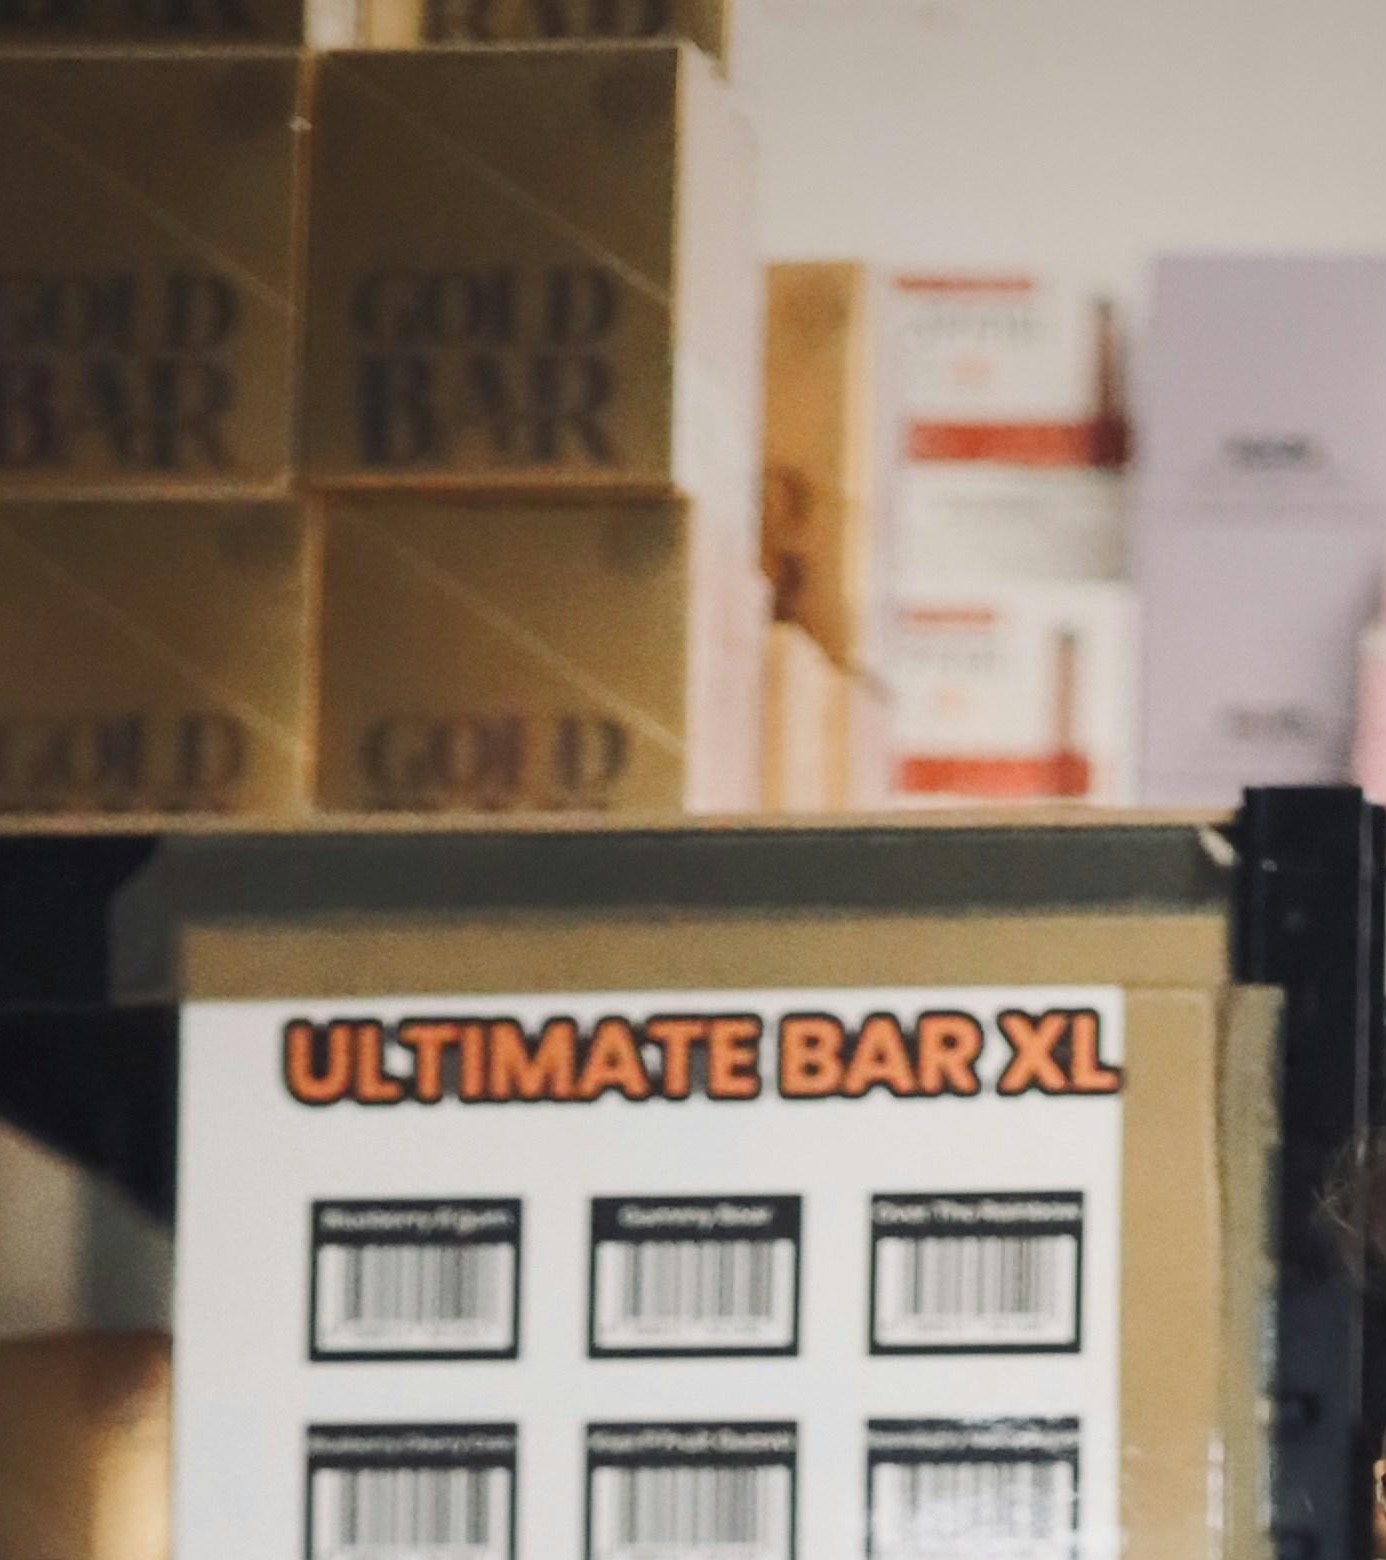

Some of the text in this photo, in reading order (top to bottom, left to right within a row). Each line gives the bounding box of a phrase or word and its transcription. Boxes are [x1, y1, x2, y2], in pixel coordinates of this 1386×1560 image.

[348, 265, 619, 344] GOLD
[358, 353, 621, 467] BAR
[284, 1009, 1123, 1105] ULTIMATE BAR XL
